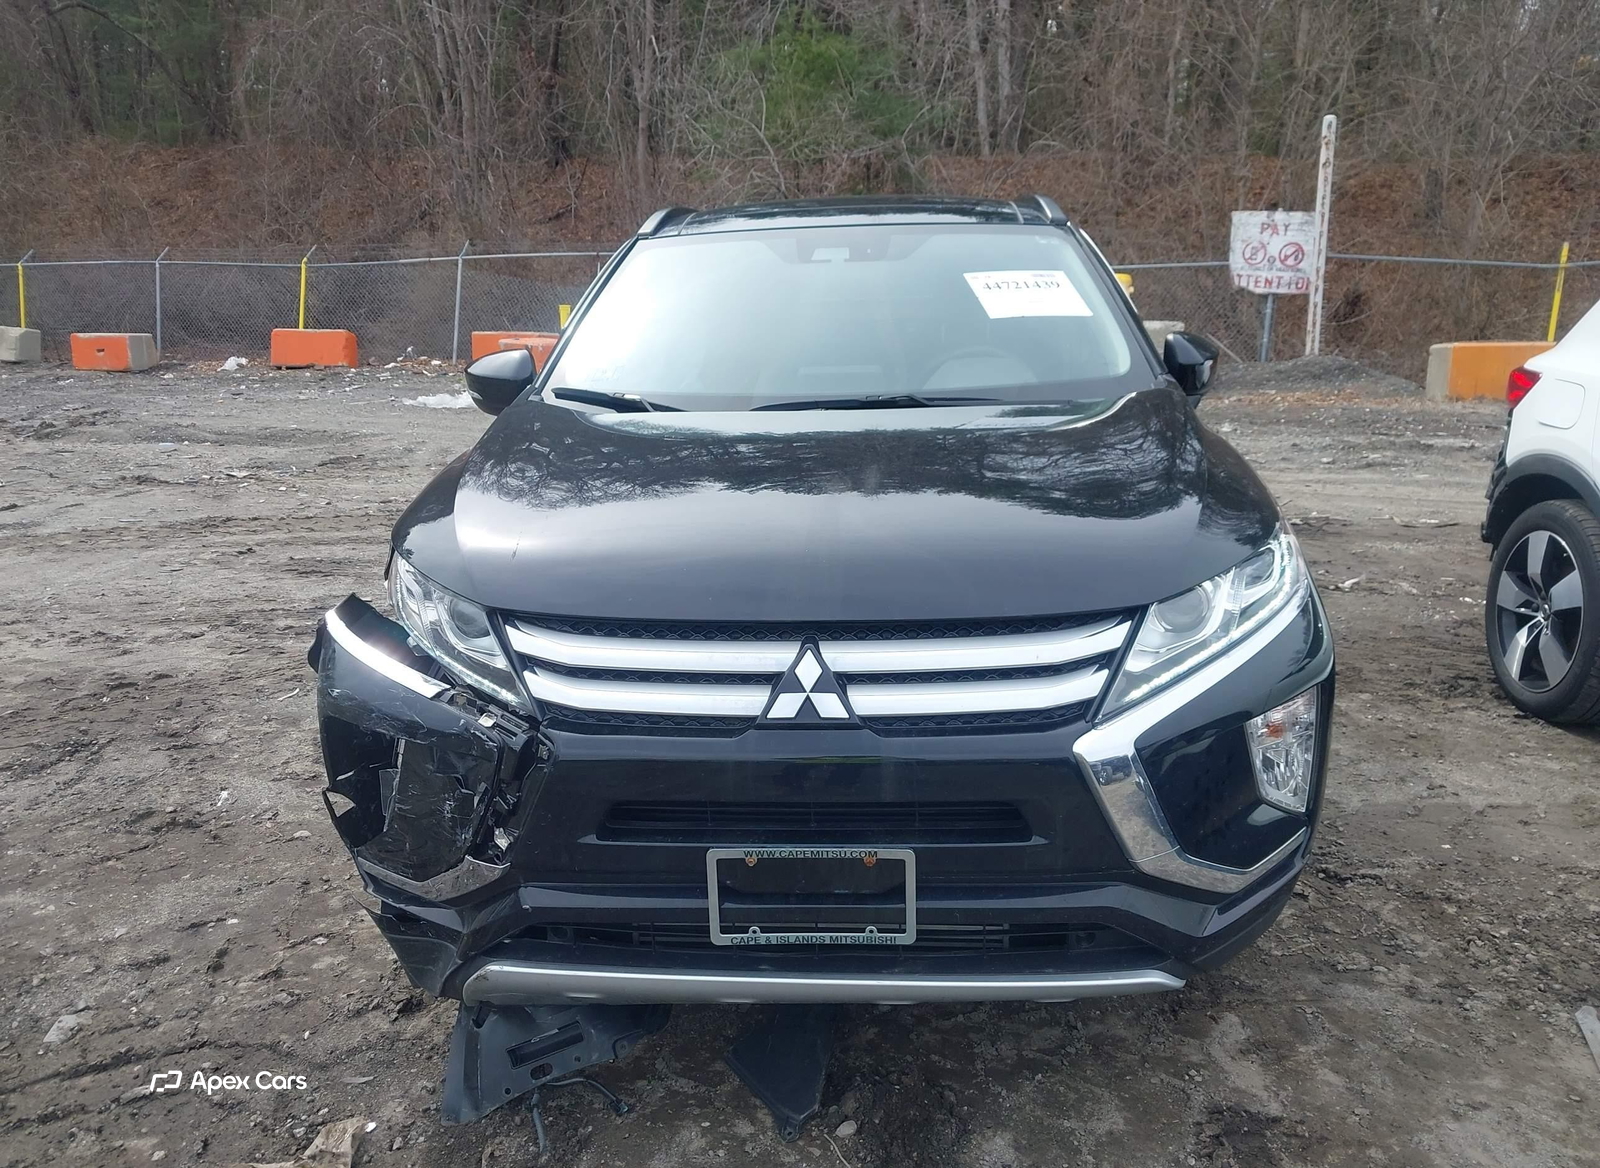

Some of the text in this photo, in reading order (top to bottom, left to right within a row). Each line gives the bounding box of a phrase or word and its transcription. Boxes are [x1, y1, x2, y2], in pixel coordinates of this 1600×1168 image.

[1260, 222, 1291, 236] PAY
[982, 280, 1060, 291] 44721439
[743, 850, 878, 858] WWW.CAPEMITSU.COM
[730, 935, 897, 945] CAPE & ISLANDS MITSUBISHI
